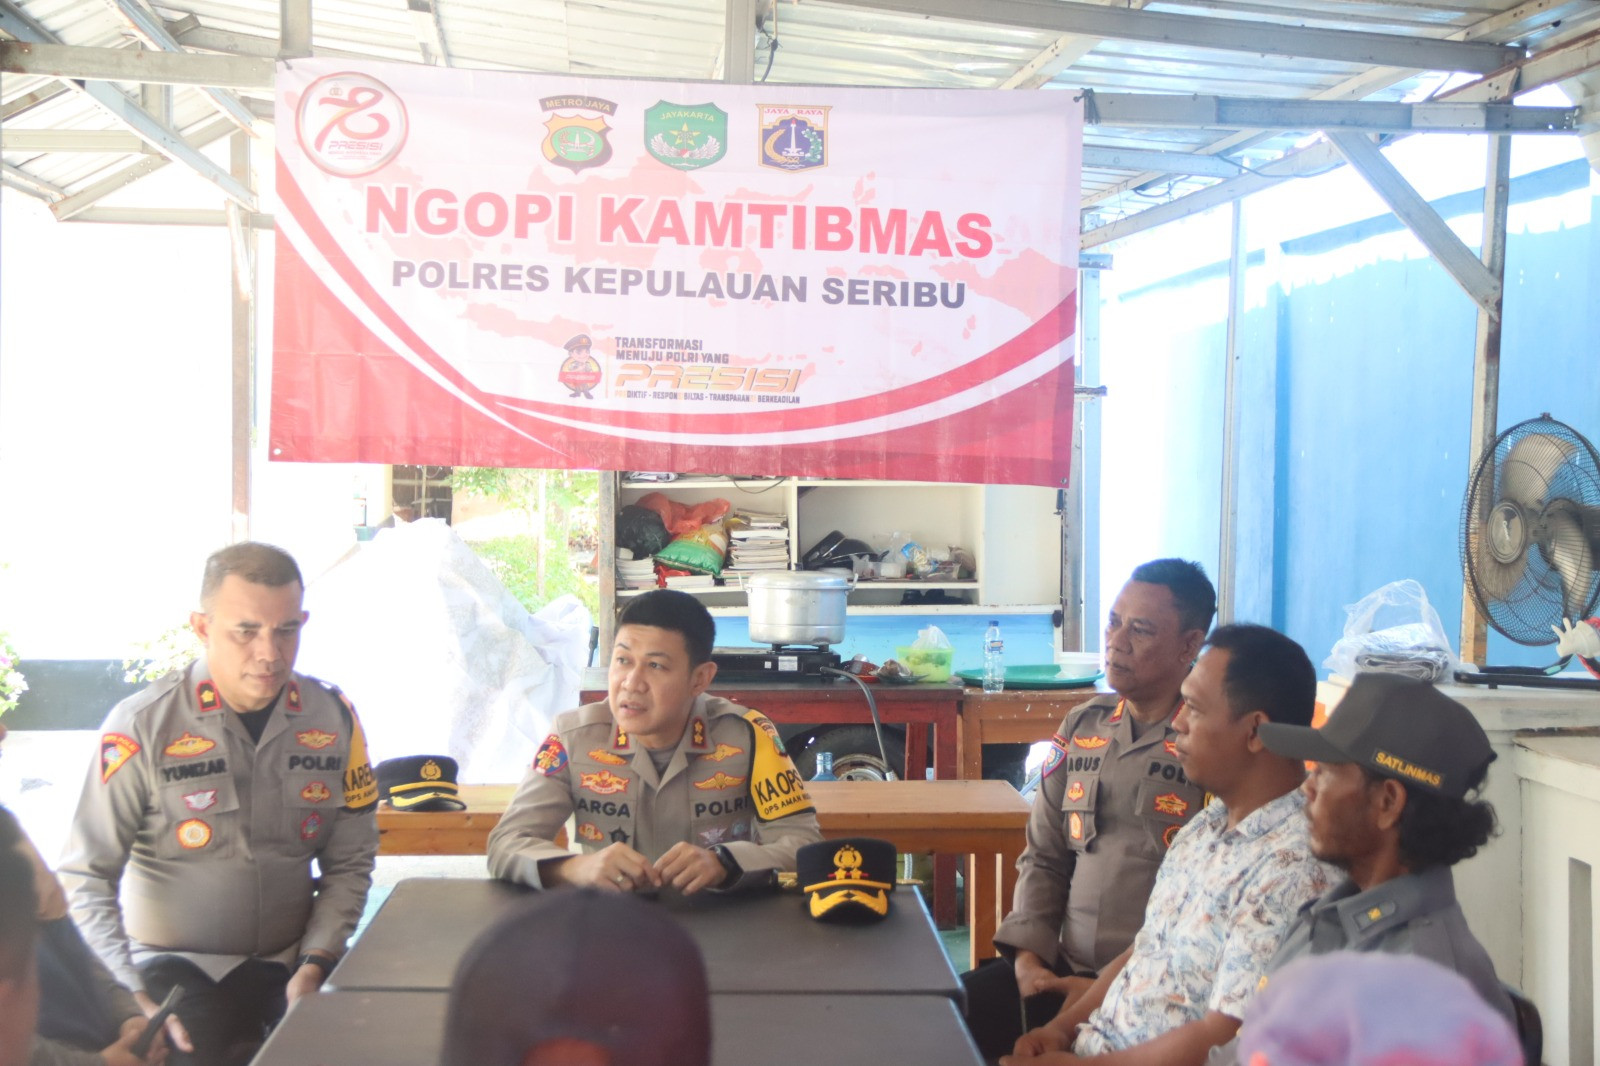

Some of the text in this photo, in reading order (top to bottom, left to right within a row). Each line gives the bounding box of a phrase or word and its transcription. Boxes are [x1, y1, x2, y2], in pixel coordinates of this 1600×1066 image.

[545, 98, 610, 112] METRO JAYA
[660, 111, 715, 122] JAYAKARTA
[328, 140, 384, 151] PRESISI
[365, 186, 993, 259] NGOPI KAMTIBMAS
[392, 260, 966, 309] POLRES KEPULAUAN SERIBU
[615, 336, 703, 351] TRANSFORMASI
[616, 350, 729, 364] MENUJU POLRI YANG
[615, 363, 802, 393] PRESISI
[758, 395, 800, 404] BERKEADILAN
[289, 755, 342, 771] POLRI
[1066, 756, 1101, 774] AGUS
[1148, 761, 1191, 786] POL
[1375, 751, 1441, 786] SATLINMAS
[343, 763, 374, 792] KARE
[577, 797, 631, 819] ARGA
[694, 795, 748, 818] POLRI
[764, 803, 780, 815] OPS
[781, 794, 802, 808] AMAN
